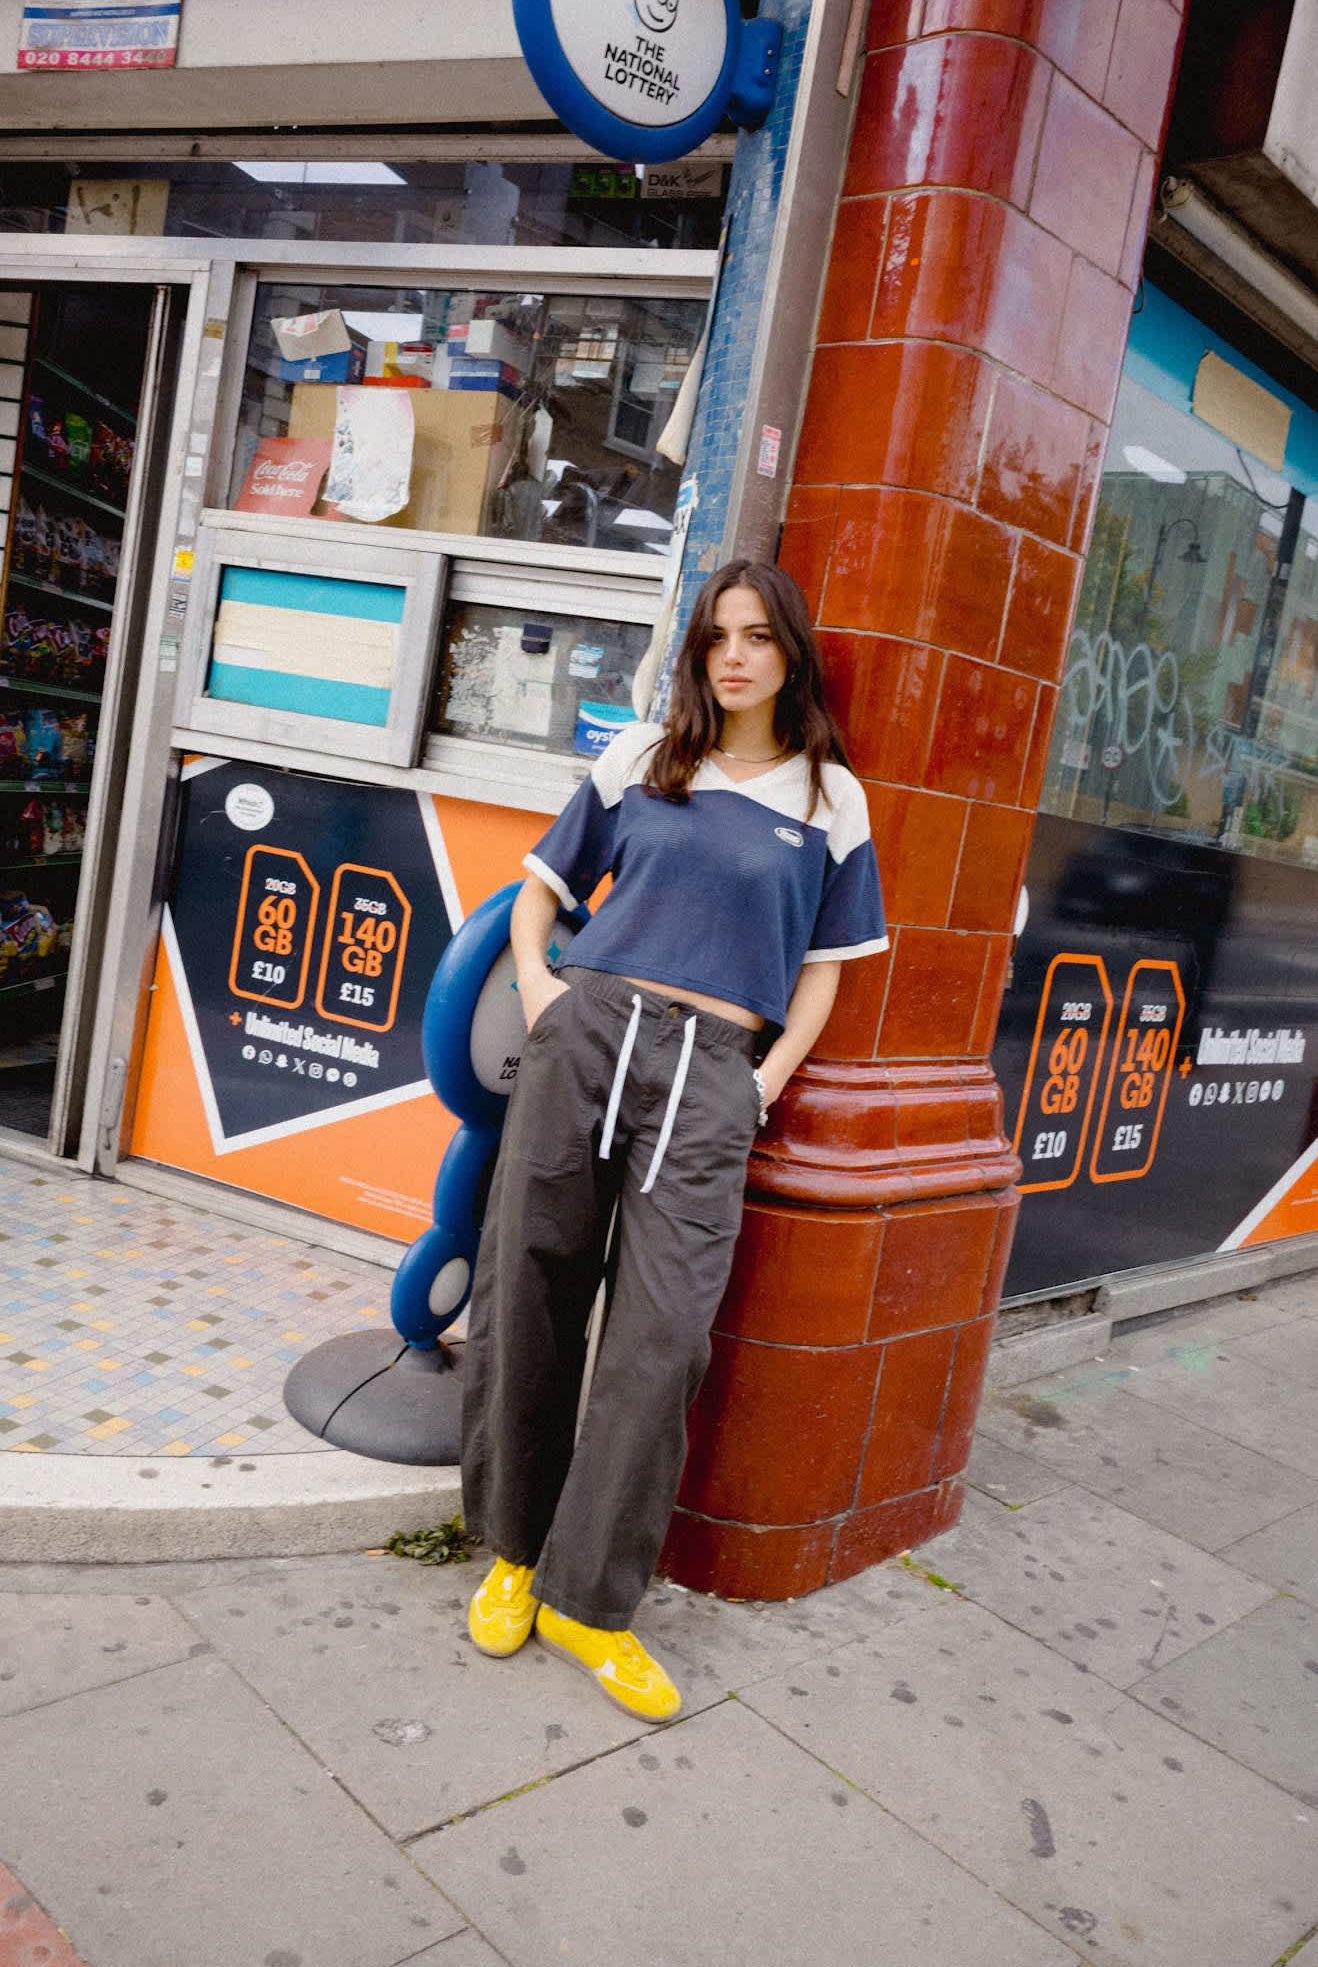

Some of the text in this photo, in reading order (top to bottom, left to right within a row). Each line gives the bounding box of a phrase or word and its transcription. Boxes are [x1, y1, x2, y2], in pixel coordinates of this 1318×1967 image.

[25, 52, 61, 65] 020
[67, 52, 114, 65] 8444
[636, 35, 665, 62] THE
[603, 43, 681, 91] NATIONAL
[604, 63, 676, 105] LOTTERY
[647, 173, 681, 187] D&K
[586, 729, 616, 743] oyst
[257, 895, 297, 930] 60
[253, 925, 294, 956] GB
[337, 911, 397, 953] 140
[251, 961, 286, 984] £10
[341, 945, 383, 977] GB
[339, 982, 375, 1007] £15
[503, 1056, 521, 1068] NA
[1048, 1027, 1088, 1074] 60
[1120, 1028, 1171, 1072] 140
[499, 1069, 518, 1080] LO
[1040, 1073, 1080, 1115] GB
[1119, 1072, 1156, 1110] GB
[1032, 1131, 1068, 1160] £10
[1112, 1124, 1144, 1151] £15
